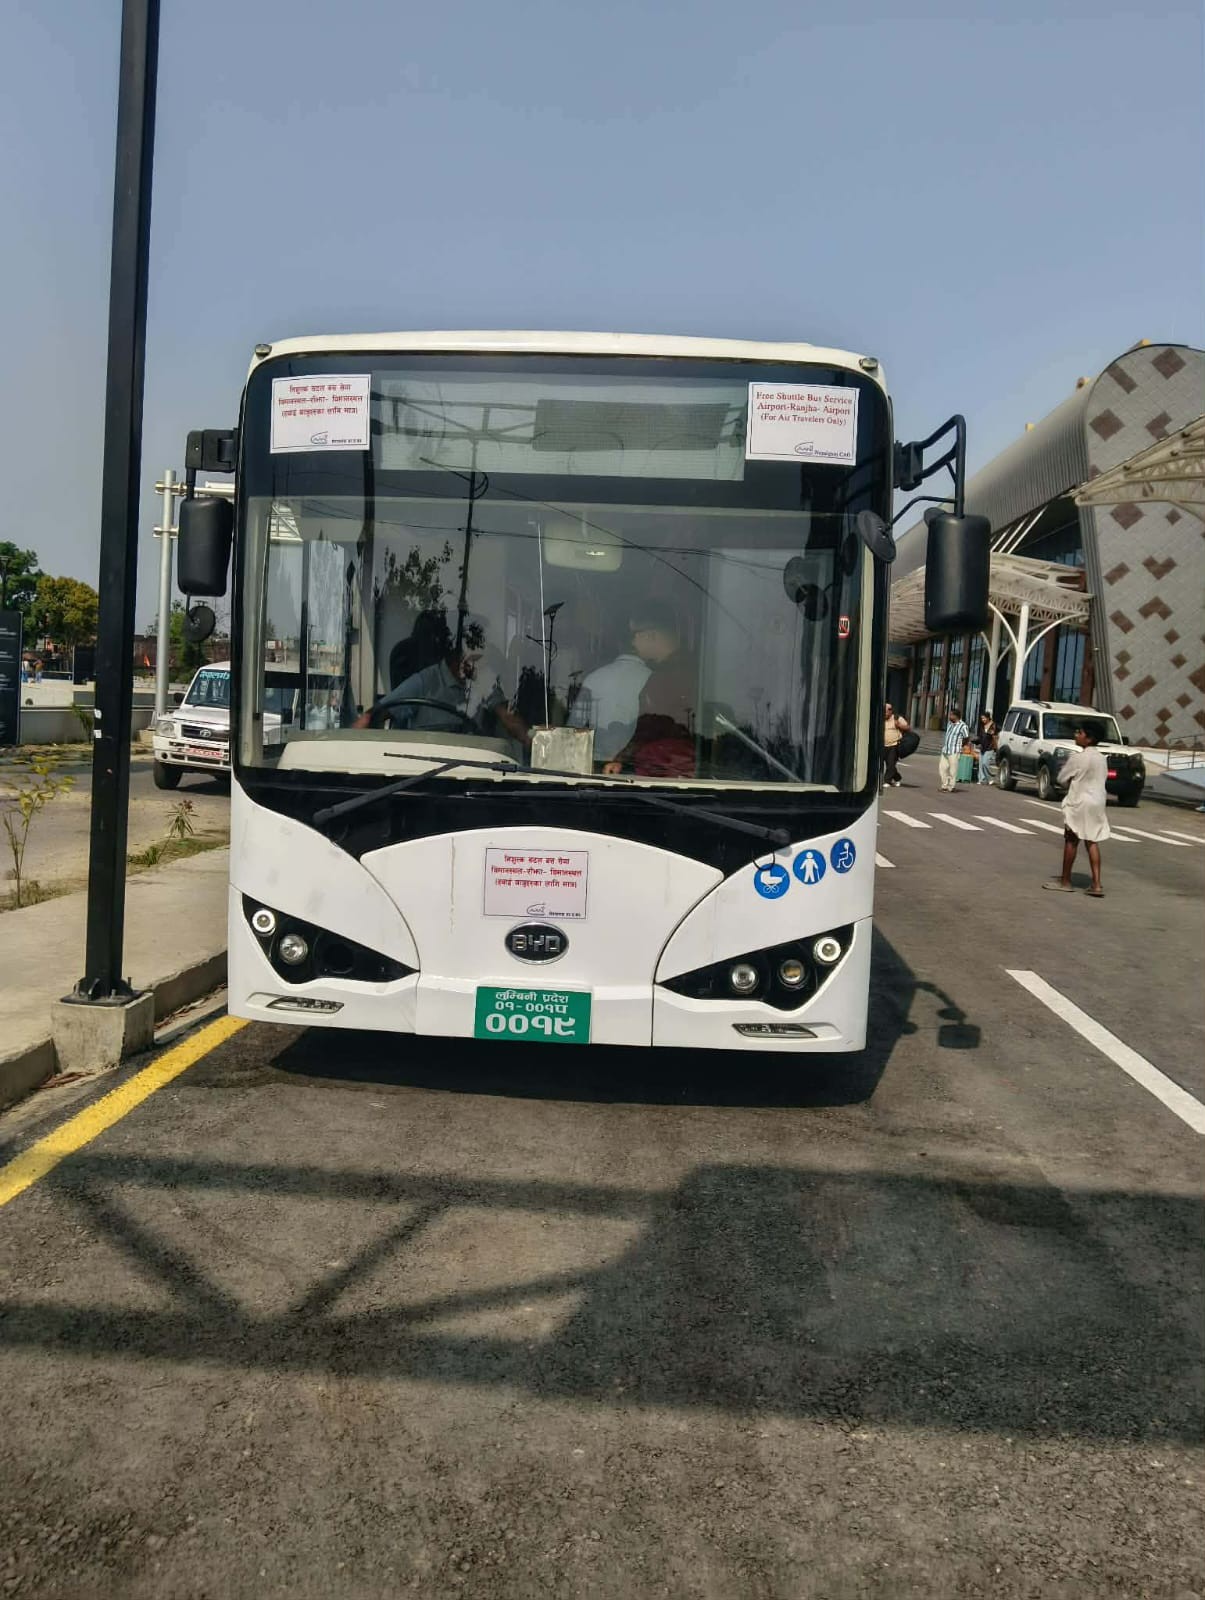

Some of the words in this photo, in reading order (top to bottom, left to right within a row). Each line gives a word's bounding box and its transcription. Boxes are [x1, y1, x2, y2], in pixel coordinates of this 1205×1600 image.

[756, 391, 774, 400] Free
[776, 392, 805, 401] Shuttle
[807, 393, 821, 402] Bus
[824, 394, 853, 404] Service
[823, 406, 851, 416] Airport
[760, 413, 776, 421] (For
[778, 413, 790, 421] Air
[791, 414, 825, 423] Travelers
[827, 417, 847, 426] Only)
[512, 934, 561, 952] BYD
[495, 989, 537, 1001] लुम्बिनी
[542, 992, 569, 1004] प्रदेश
